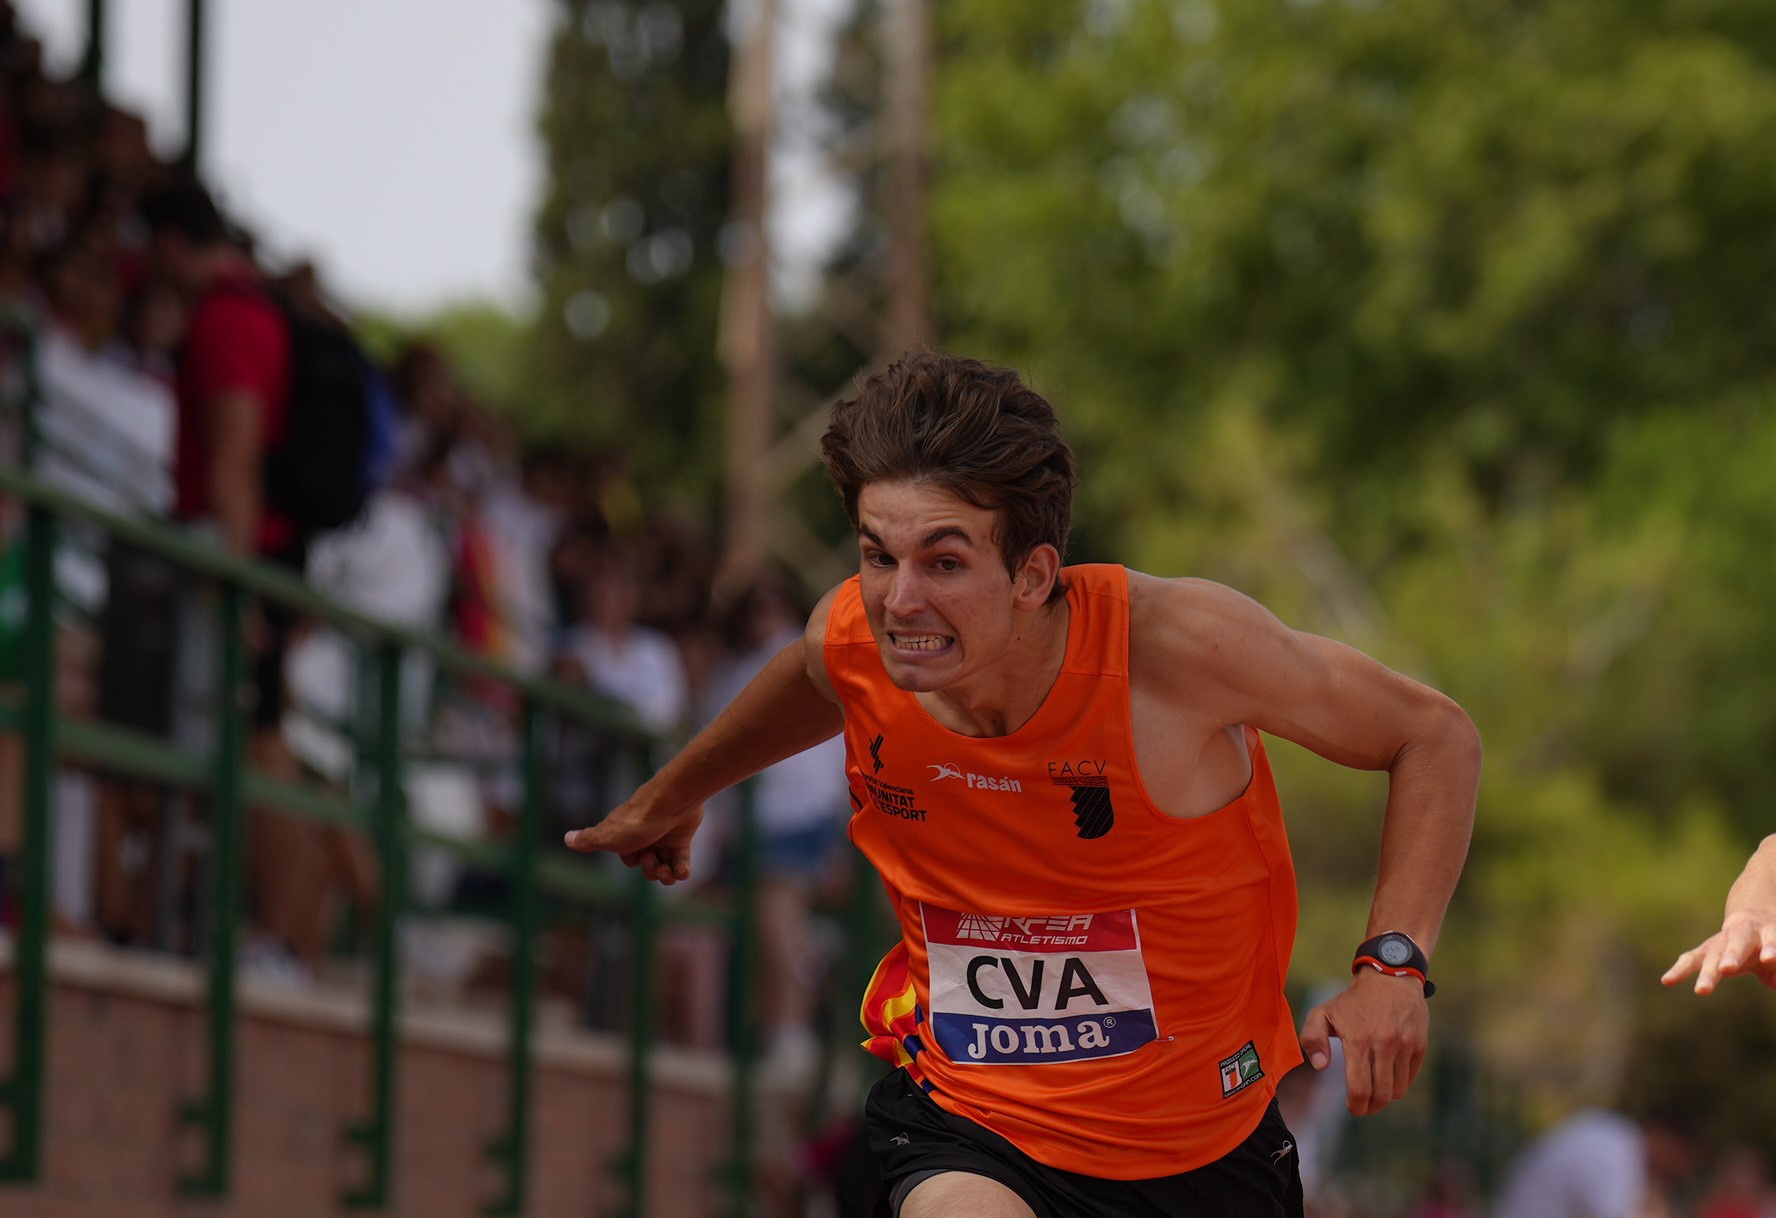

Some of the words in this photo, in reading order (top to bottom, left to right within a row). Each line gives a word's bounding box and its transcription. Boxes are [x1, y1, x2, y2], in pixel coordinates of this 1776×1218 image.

[1048, 760, 1106, 778] FACV
[1001, 933, 1088, 945] ATLETISMO
[967, 955, 1109, 1010] CVA
